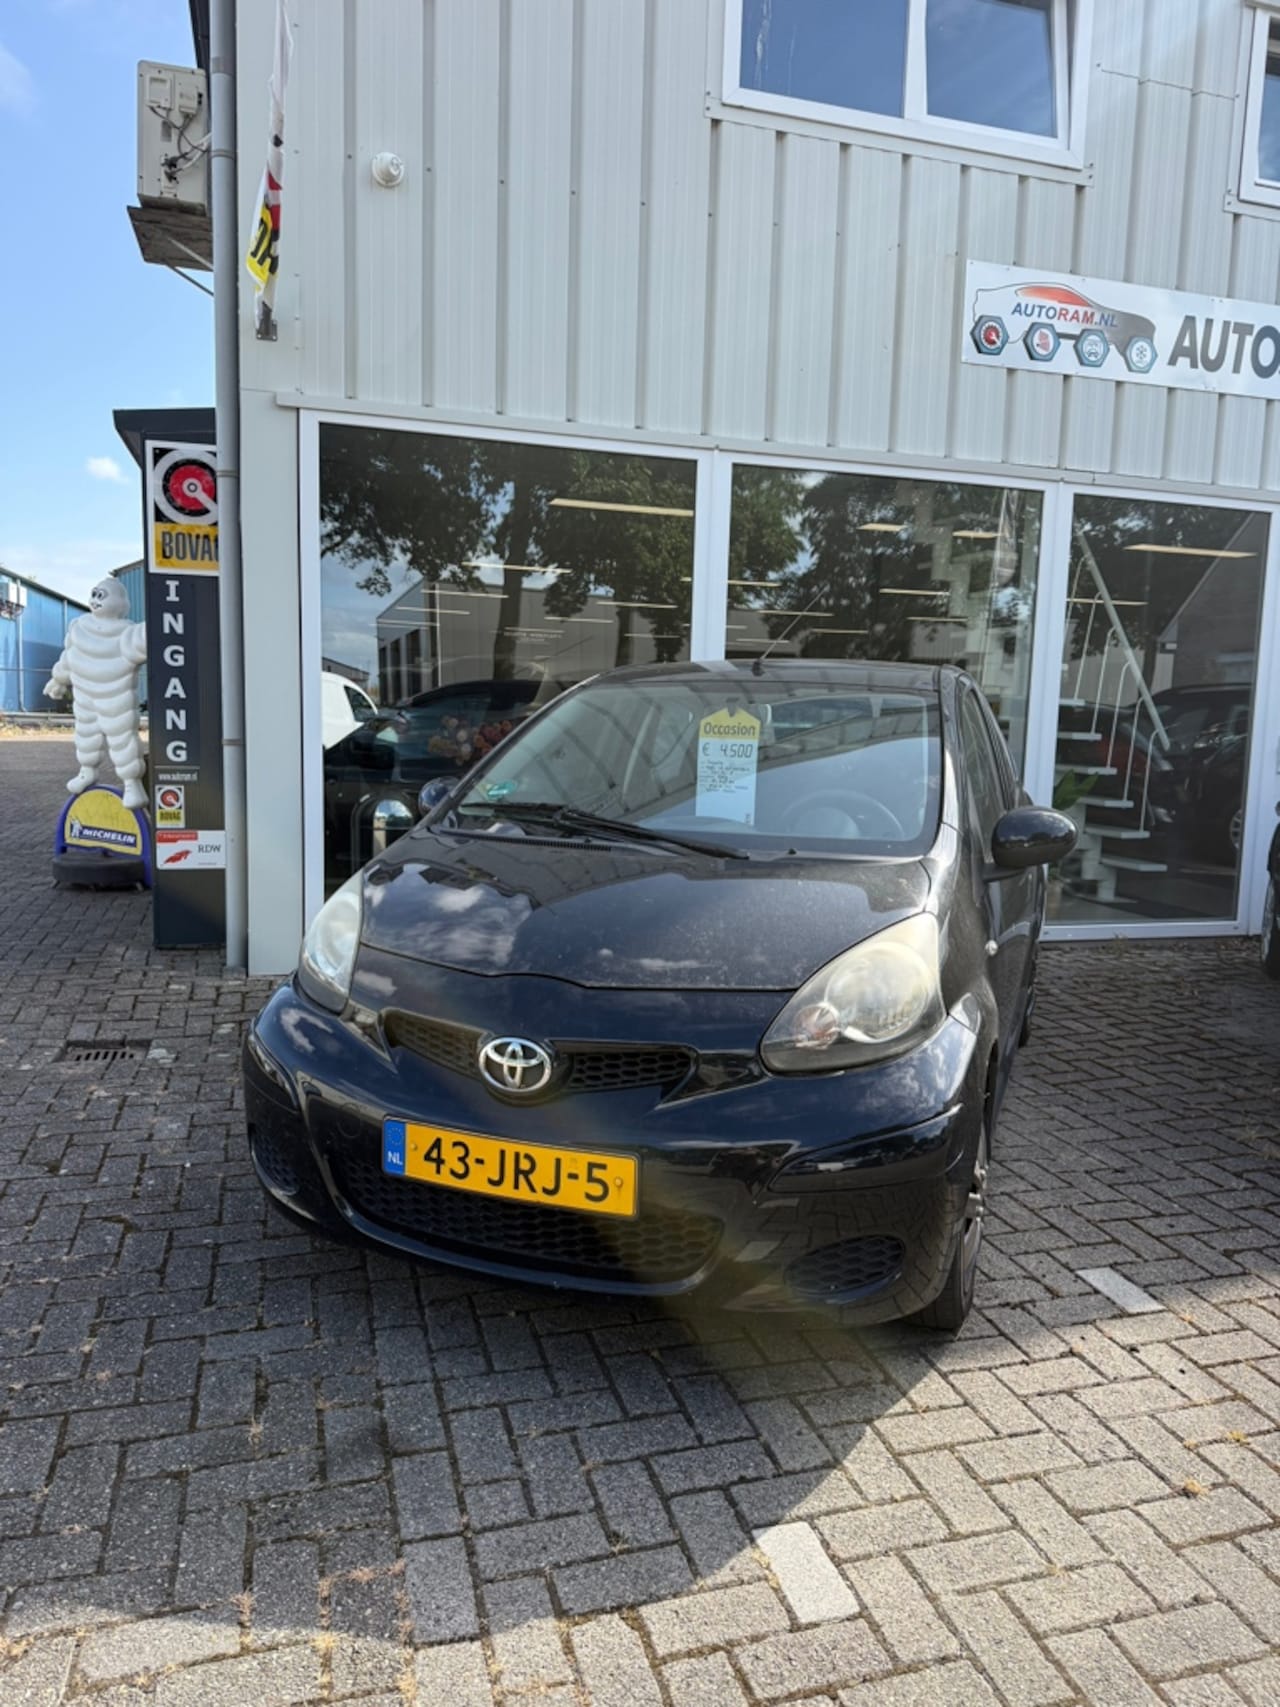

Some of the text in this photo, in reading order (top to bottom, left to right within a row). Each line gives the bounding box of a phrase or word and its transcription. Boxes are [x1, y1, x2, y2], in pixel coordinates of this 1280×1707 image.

[1011, 302, 1118, 328] AUTORAM.NL
[1167, 315, 1280, 379] AUTO
[162, 580, 188, 762] INGANG
[703, 721, 756, 736] Occasion
[82, 829, 136, 844] MICHELIN
[198, 844, 221, 853] RDW
[388, 1137, 609, 1202] NL 43-JRJ-5
